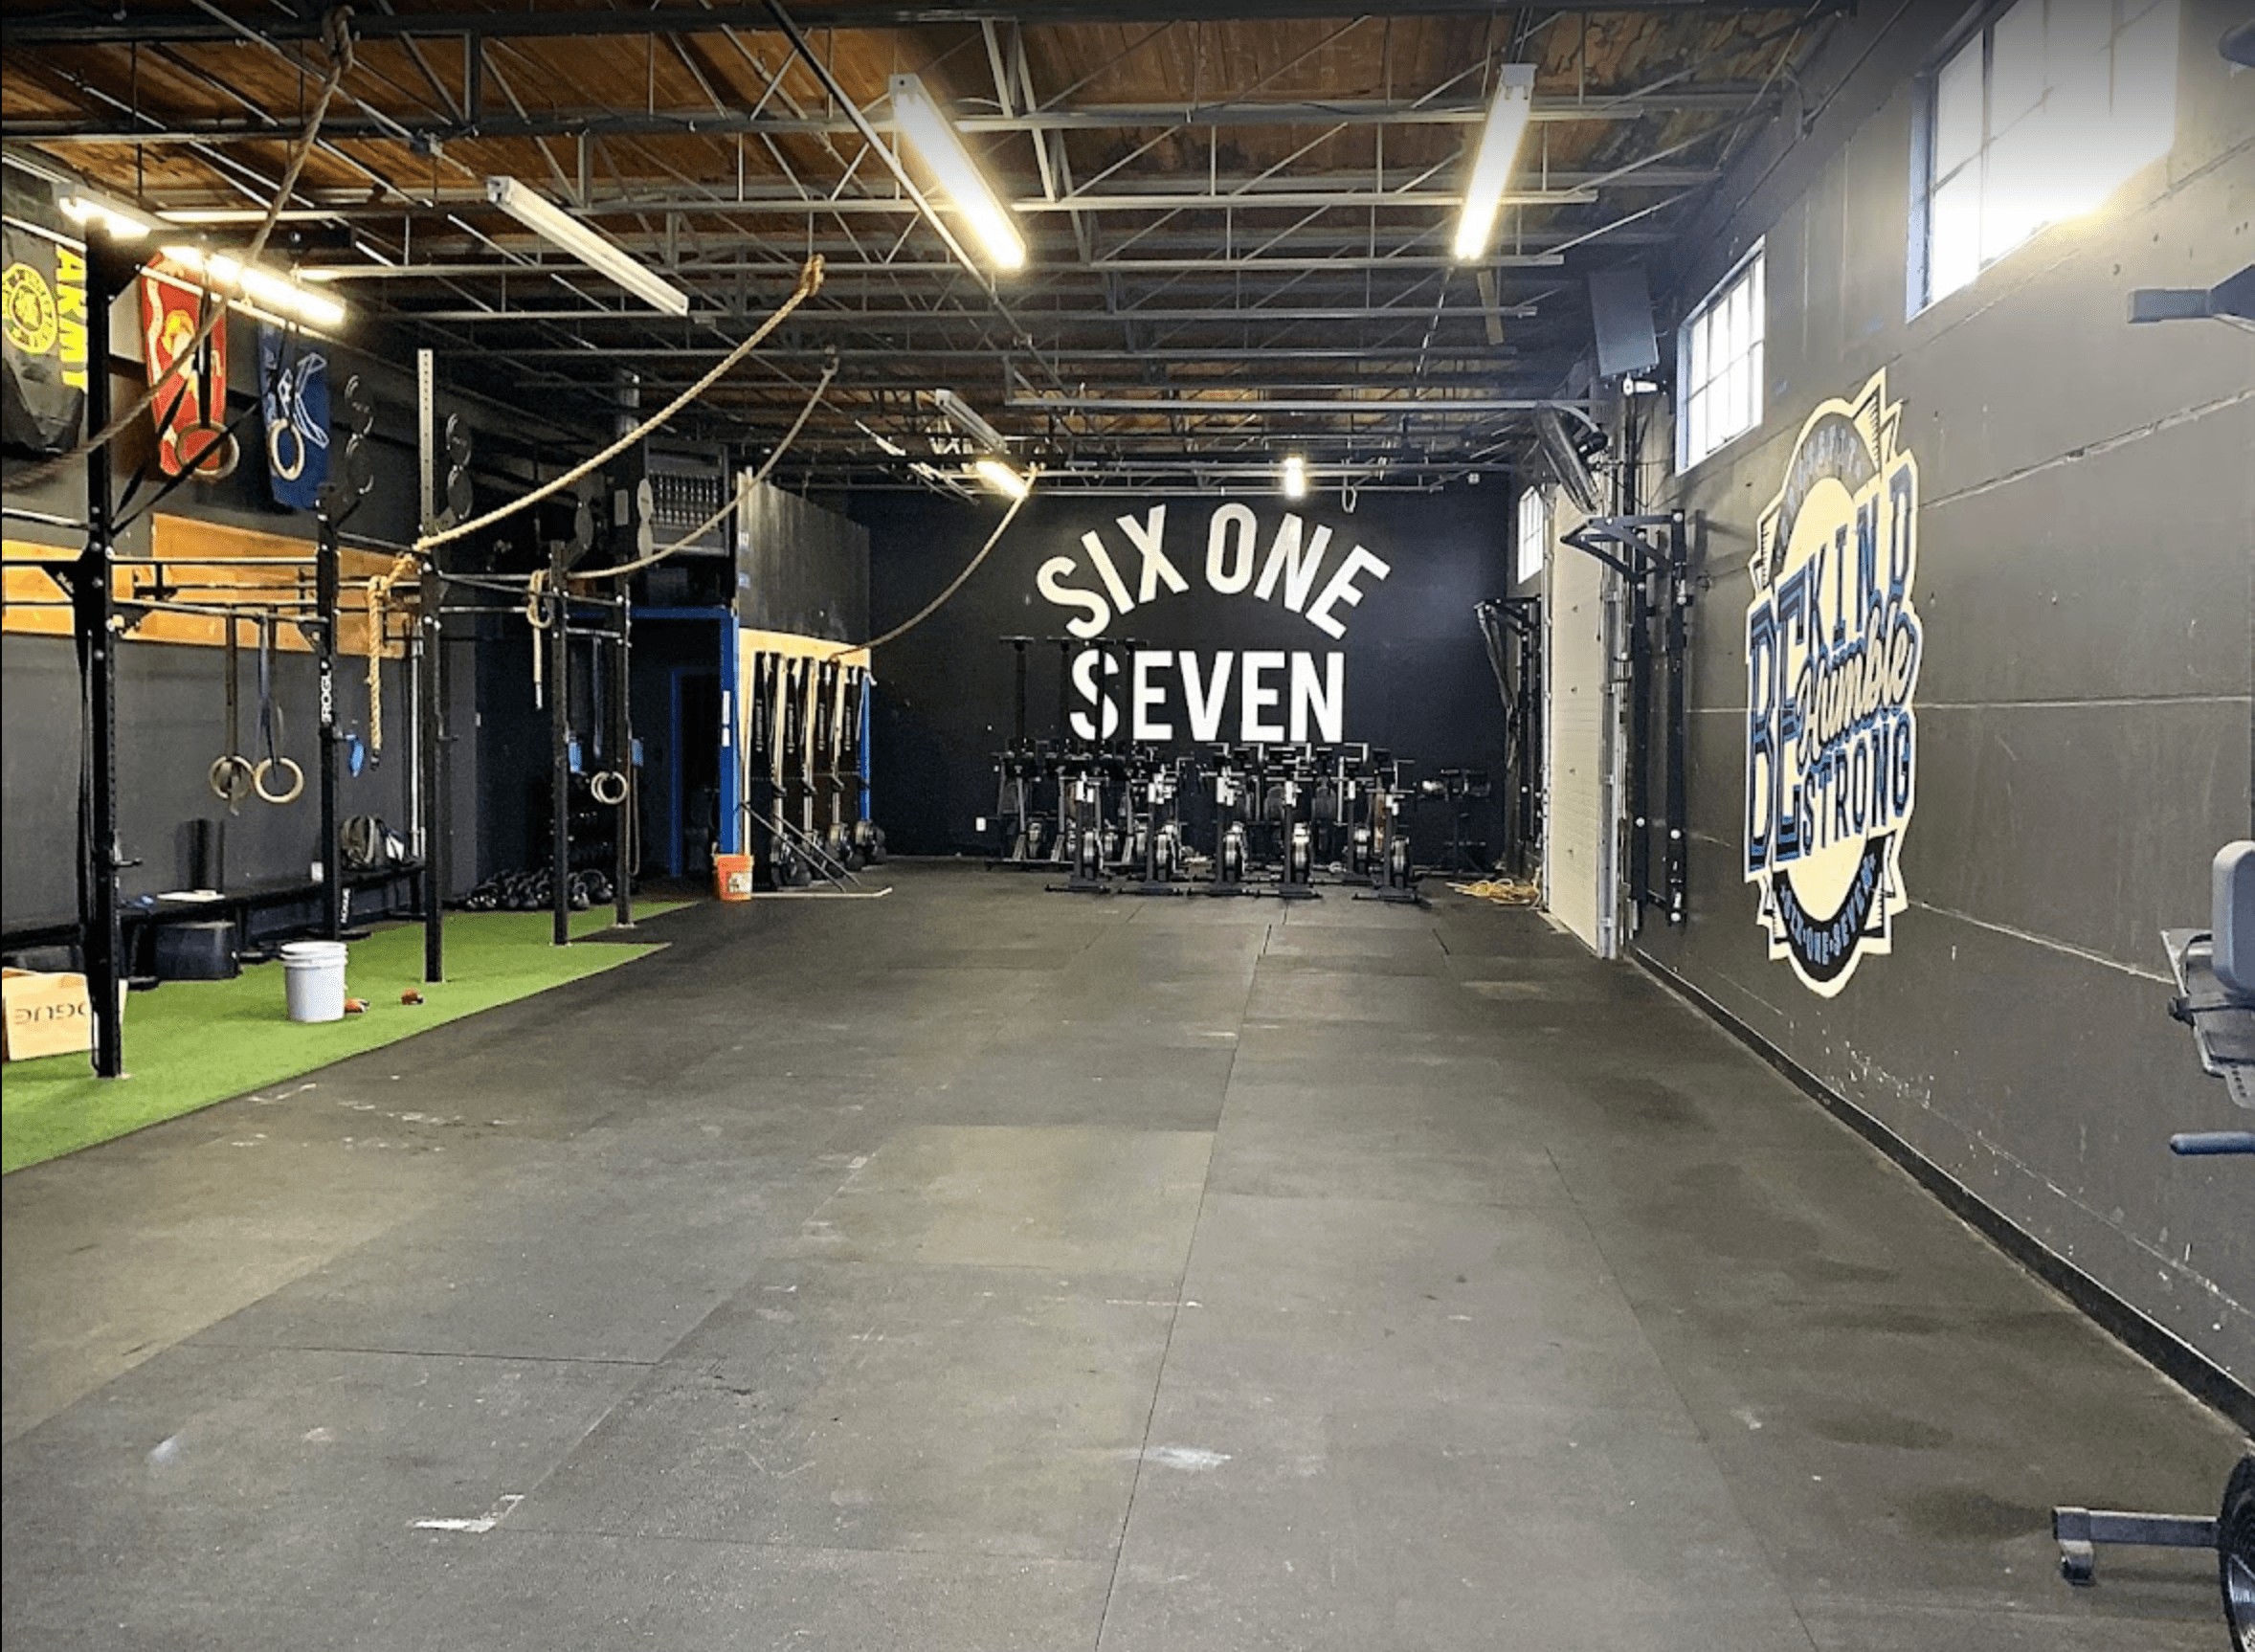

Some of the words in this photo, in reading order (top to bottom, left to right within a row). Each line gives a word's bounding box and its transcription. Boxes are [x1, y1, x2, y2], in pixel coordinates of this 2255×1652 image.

[1036, 504, 1190, 638] SIX
[1205, 502, 1391, 640] ONE
[1069, 648, 1345, 744] SEVEN
[1749, 564, 1807, 872] BE
[1807, 462, 1913, 657] KIND
[1797, 601, 1915, 769] Humble
[1802, 713, 1911, 856] STRONG
